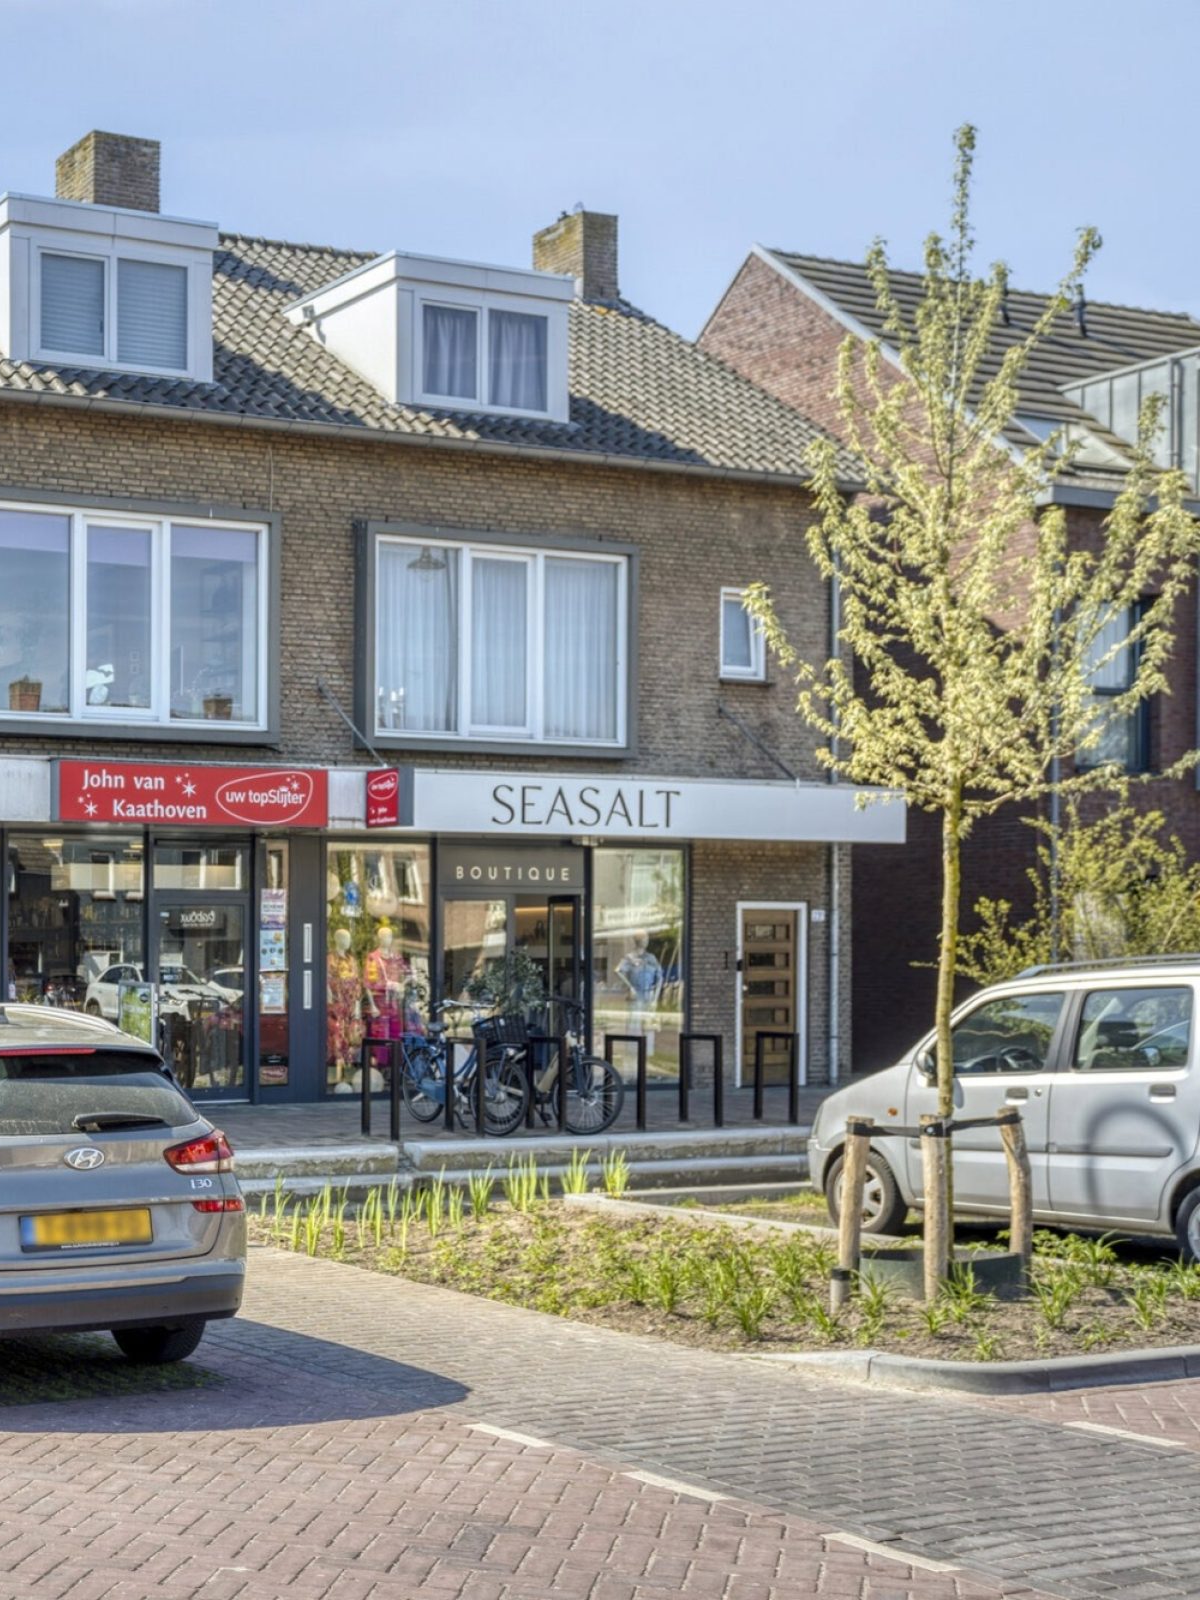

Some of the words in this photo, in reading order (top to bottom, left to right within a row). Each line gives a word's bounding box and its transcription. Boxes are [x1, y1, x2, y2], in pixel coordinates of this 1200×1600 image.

[82, 768, 125, 790] John
[133, 776, 165, 791] van
[112, 799, 207, 819] Kaathoven
[491, 784, 681, 829] SEASALT
[455, 866, 570, 882] BOUTIQUE
